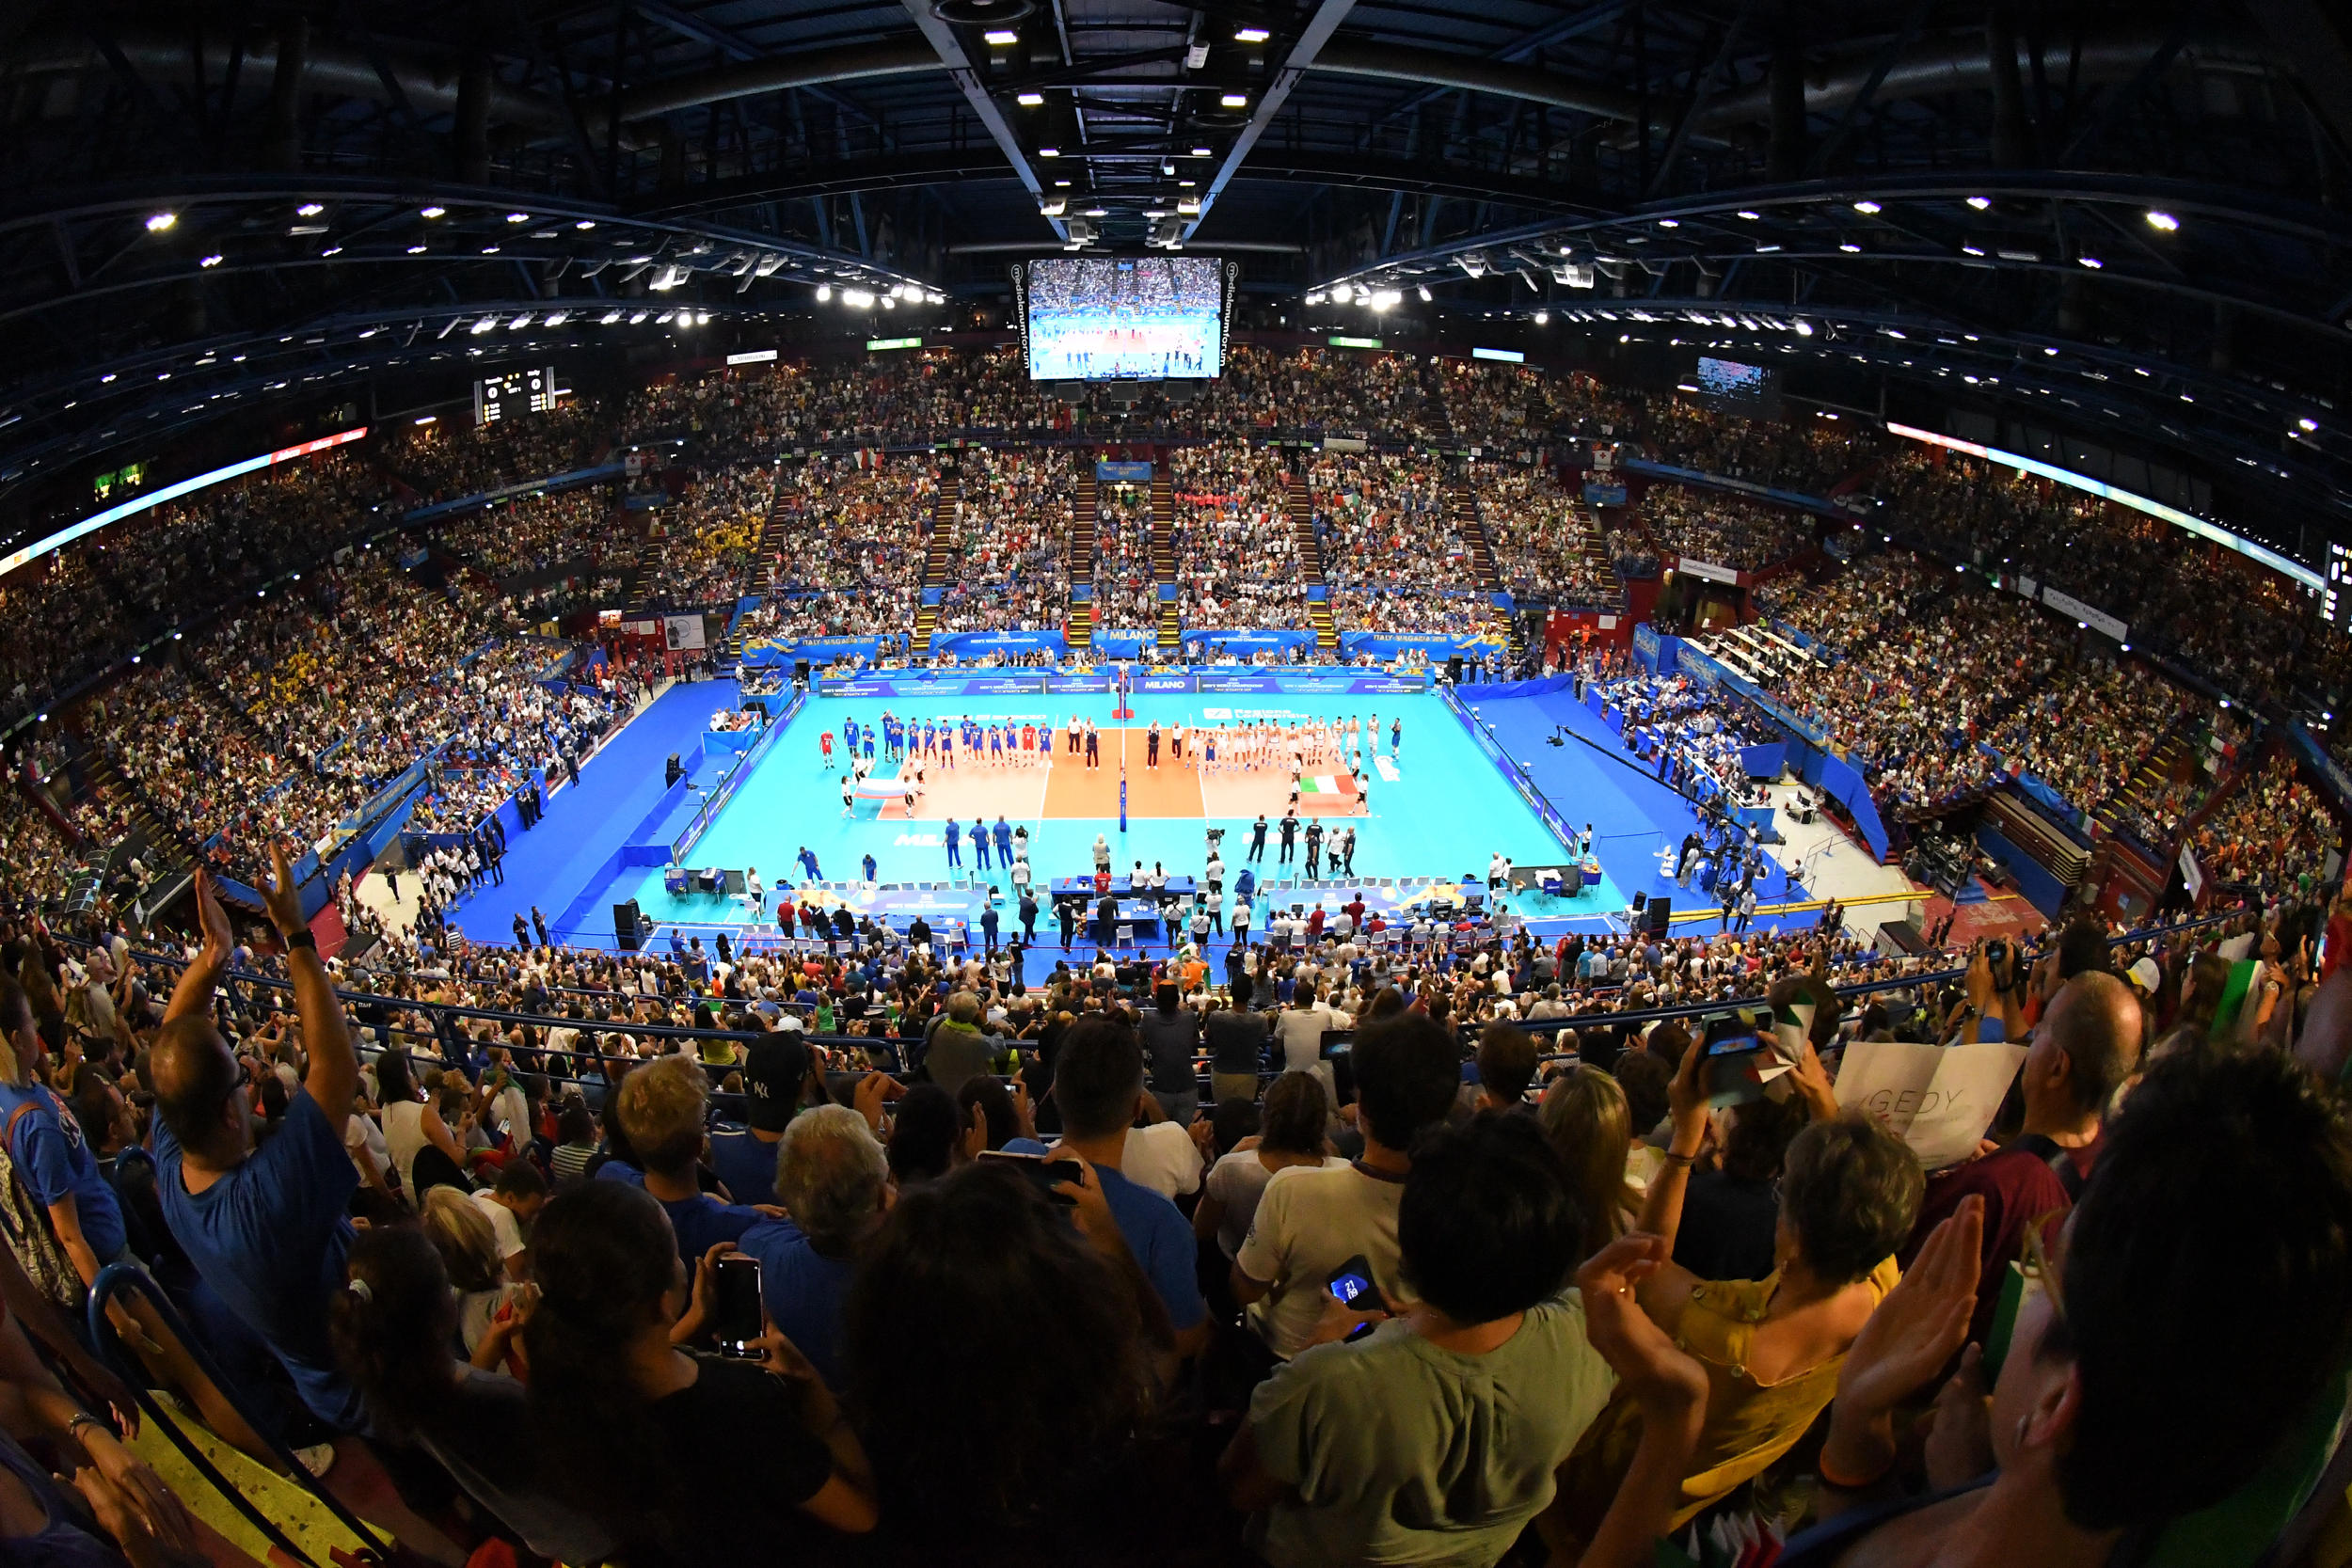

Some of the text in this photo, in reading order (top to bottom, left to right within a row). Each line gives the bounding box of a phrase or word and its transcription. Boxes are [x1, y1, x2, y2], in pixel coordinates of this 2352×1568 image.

[1011, 264, 1030, 369] mediolanumforum
[1220, 262, 1239, 366] mediolanumforum
[1110, 630, 1156, 641] MILANO
[754, 1081, 770, 1099] NY
